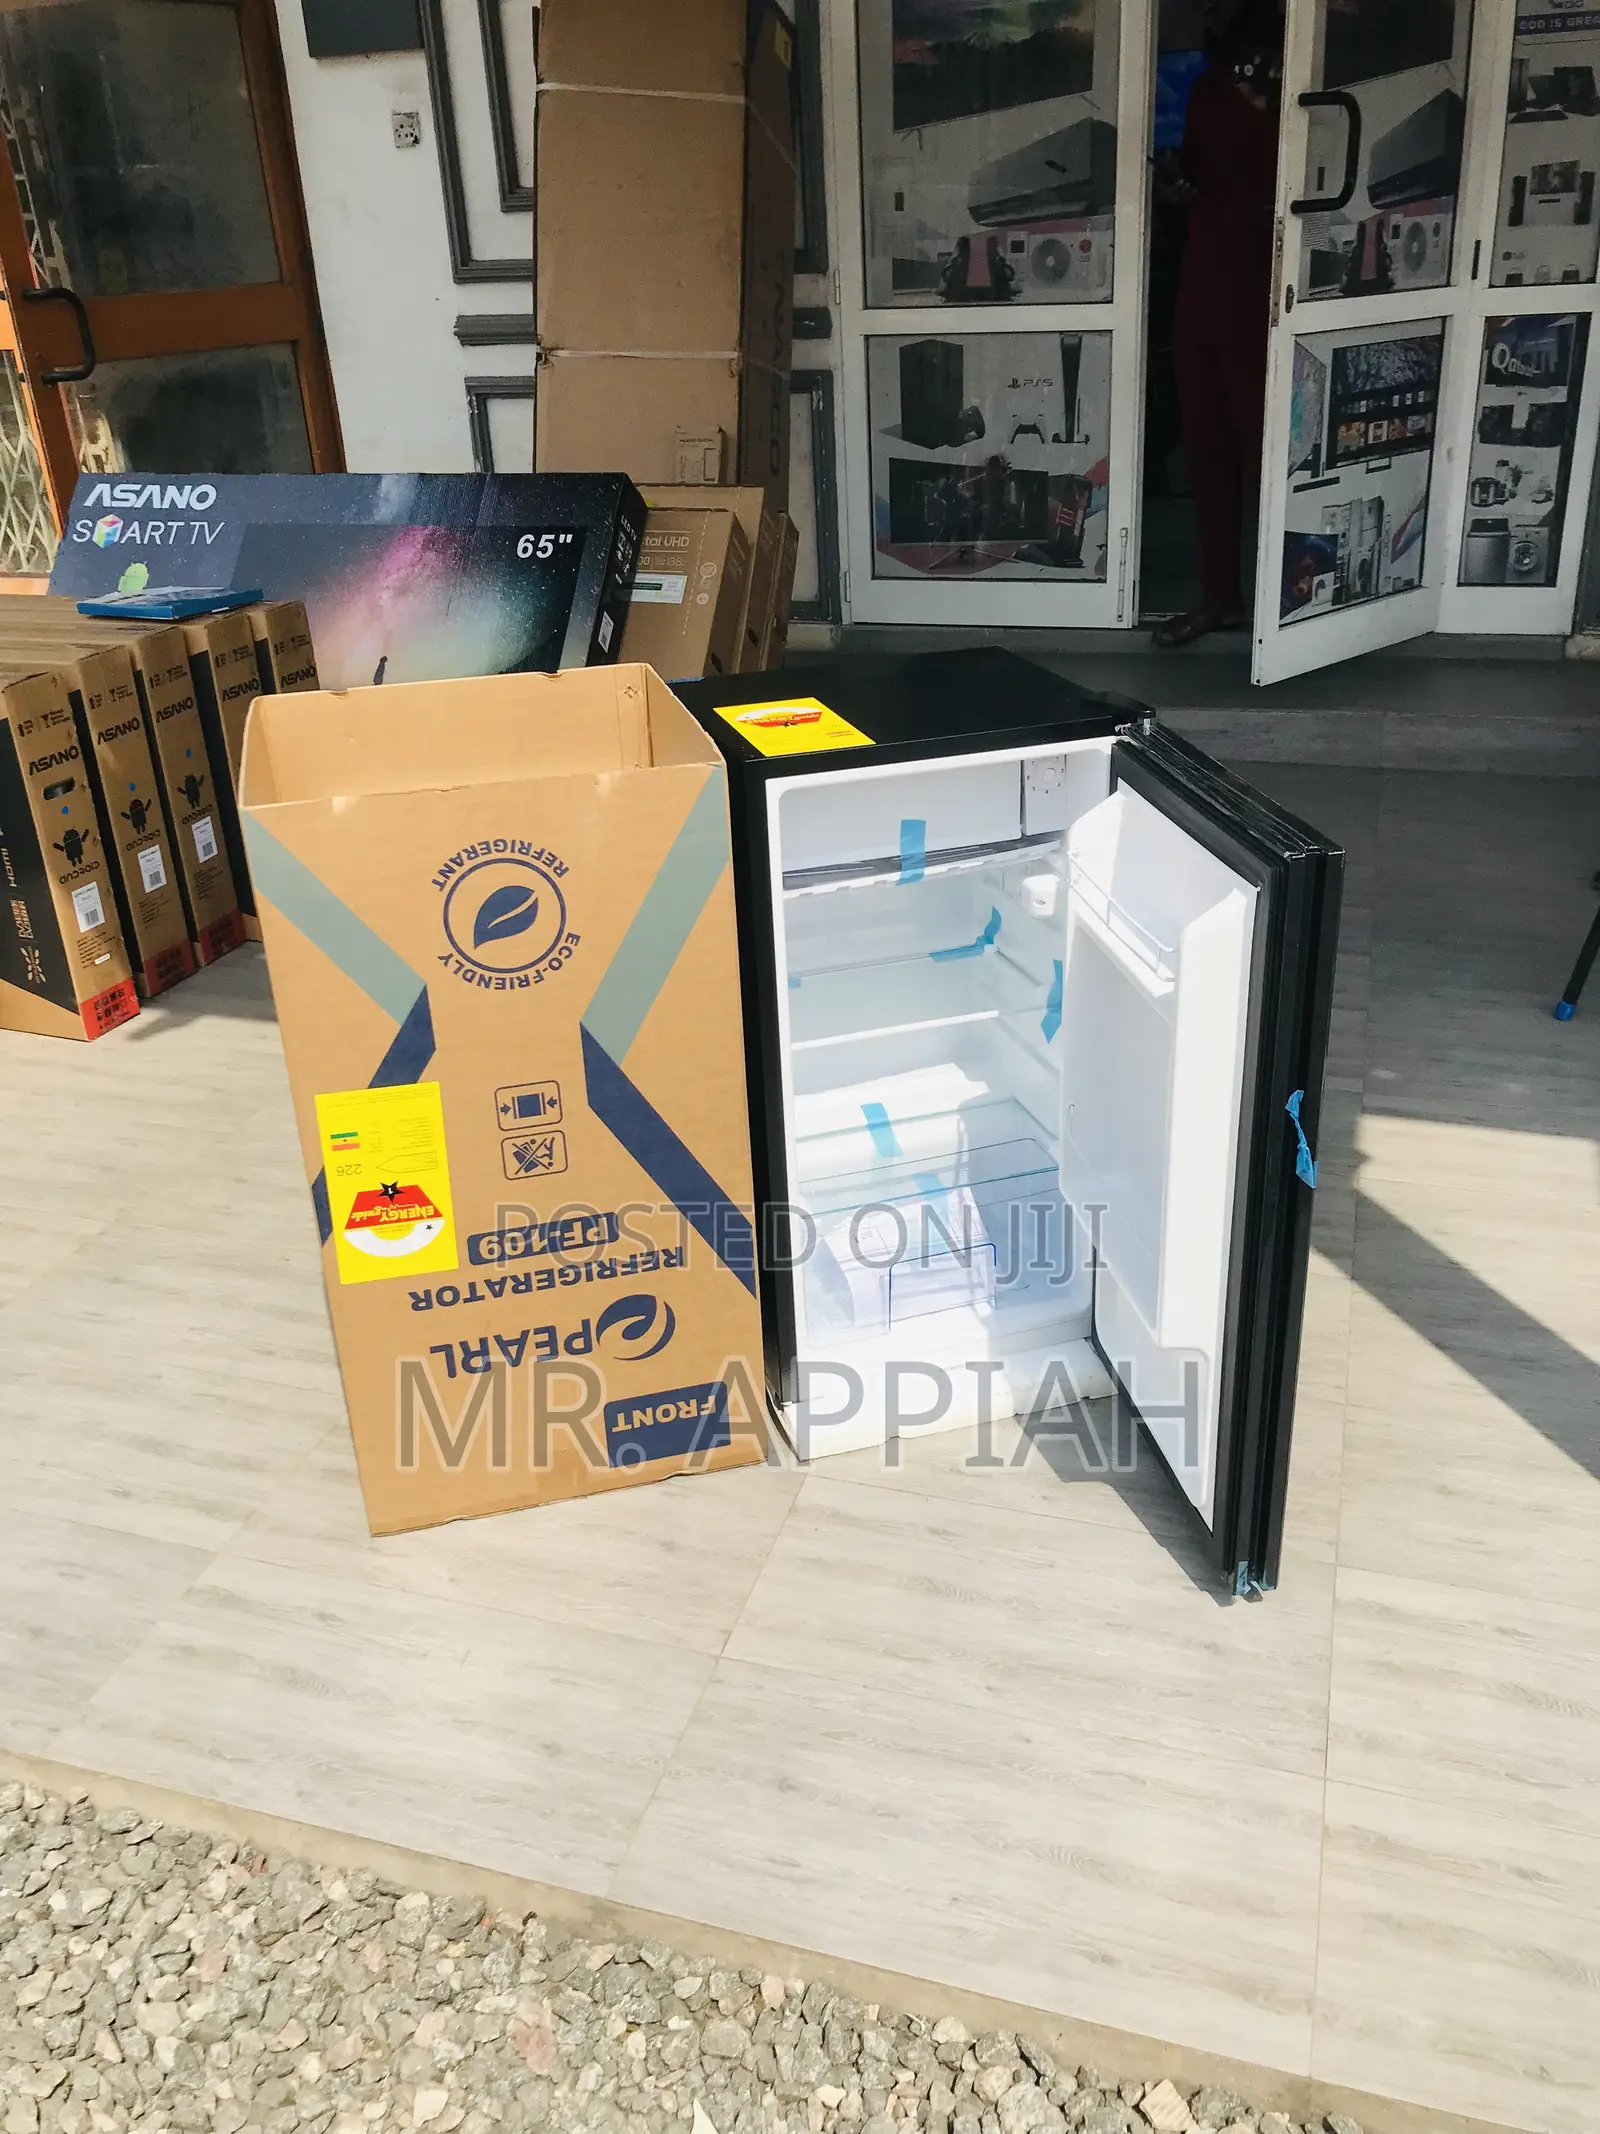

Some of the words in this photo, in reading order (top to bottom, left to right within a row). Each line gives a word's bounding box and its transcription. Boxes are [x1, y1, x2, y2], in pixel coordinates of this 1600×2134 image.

[1023, 378, 1053, 388] PS5
[83, 483, 217, 511] ASANO
[190, 520, 226, 545] TV
[516, 533, 573, 559] 65"
[664, 536, 690, 547] UHD
[221, 677, 260, 702] ASANO
[279, 666, 317, 688] ASANO
[155, 696, 194, 723] ASANO
[97, 717, 141, 745] ASANO
[29, 745, 80, 776] ASANO
[431, 838, 570, 892] REFRIGERANT
[437, 932, 581, 990] ECO-FRIENDLY
[336, 1163, 362, 1176] 226
[351, 1206, 382, 1222] guide
[379, 1204, 435, 1222] ENERGY
[479, 1216, 610, 1260] PF-109
[408, 1246, 685, 1311] REFRIGERATOR
[430, 1318, 593, 1379] PEARL
[611, 1393, 718, 1433] FRONT
